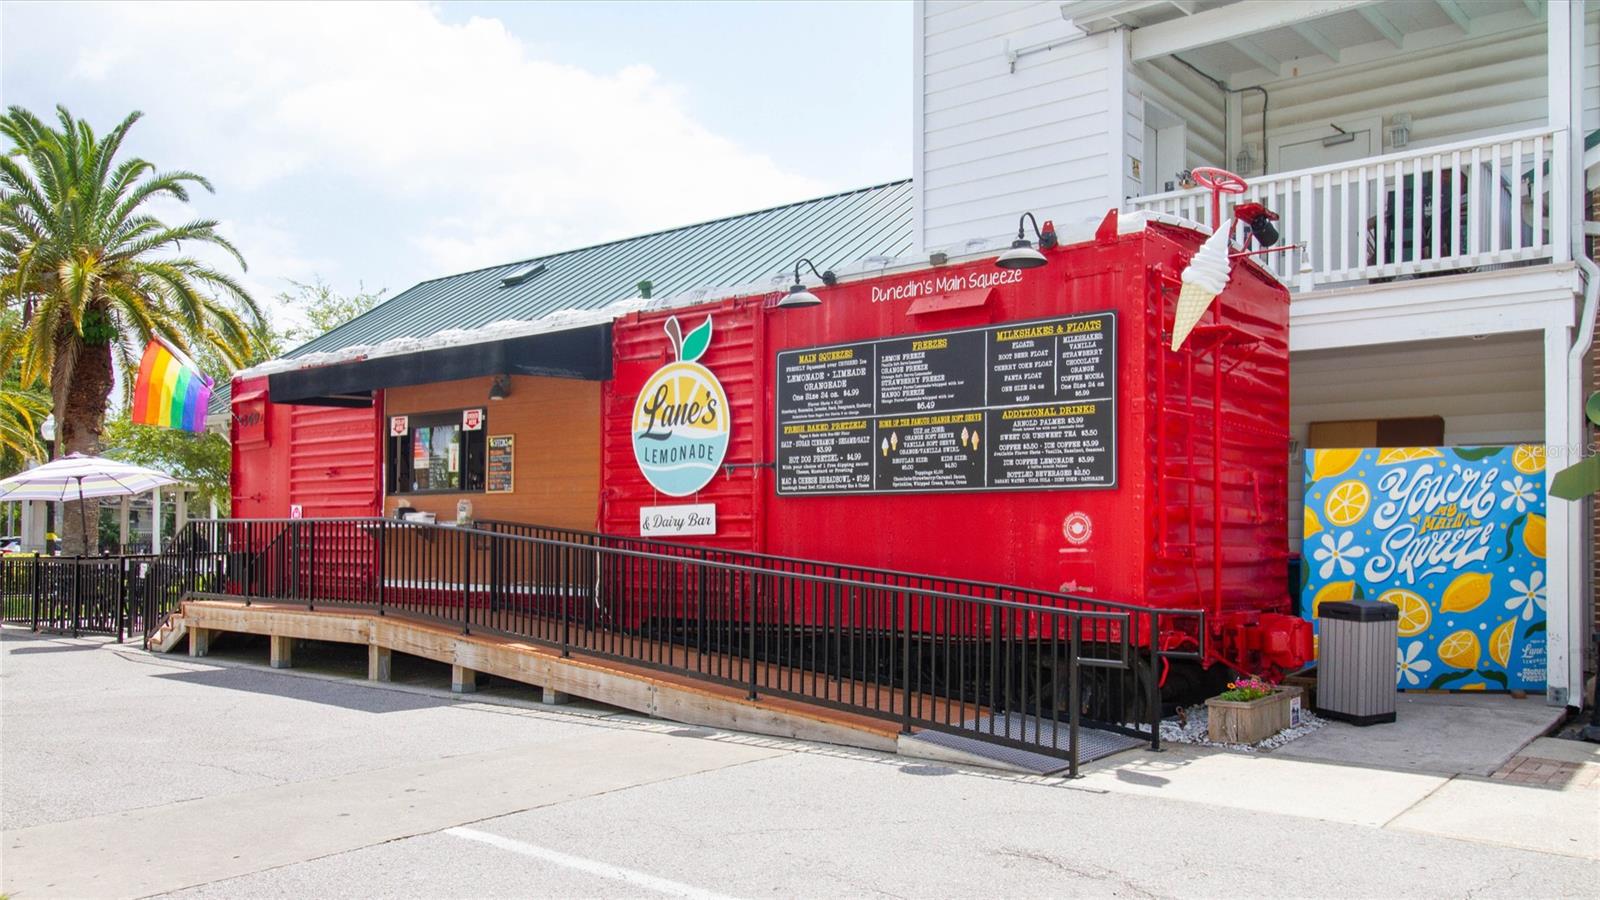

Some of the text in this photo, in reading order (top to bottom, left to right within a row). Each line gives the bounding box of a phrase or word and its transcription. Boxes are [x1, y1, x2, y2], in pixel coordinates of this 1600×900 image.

[872, 269, 1023, 303] Dunedin's Main Squeeze
[997, 326, 1053, 341] MILKSHAKES
[1067, 320, 1101, 332] FLOATS
[1063, 333, 1103, 343] MILKSHAKES
[912, 339, 948, 351] FREEZES
[1012, 341, 1034, 349] FLOATS
[1069, 341, 1096, 349] VANILLA
[799, 350, 853, 364] MAIN SQUEEZES
[903, 352, 925, 360] FREEZE
[1063, 349, 1103, 358] STRAWBERRY
[1066, 357, 1099, 366] CHOCOLATE
[881, 364, 928, 374] ORANGE FREEZE
[787, 368, 866, 383] LEMONADE LIMEADE
[804, 380, 847, 391] ORANGEADE
[881, 377, 920, 386] STRAWBERRY
[917, 401, 935, 410] $6.49
[639, 384, 717, 441] Lane's
[1002, 405, 1095, 419] ADDITIONAL DRINKS
[911, 417, 929, 426] FAMOUS
[931, 416, 950, 424] ORANGE
[951, 415, 963, 423] SOFT
[965, 413, 982, 422] SERVE
[1013, 419, 1038, 427] ARNOLD
[784, 425, 804, 434] FRESH
[832, 421, 866, 430] PRETZELS
[644, 443, 713, 464] LEMONADE
[813, 454, 838, 462] PRETZEL
[1040, 457, 1074, 465] LEMONADE
[1036, 469, 1072, 477] BEVERAGES
[819, 475, 851, 484] BREADBOWL
[643, 512, 712, 531] & Dairy Bar
